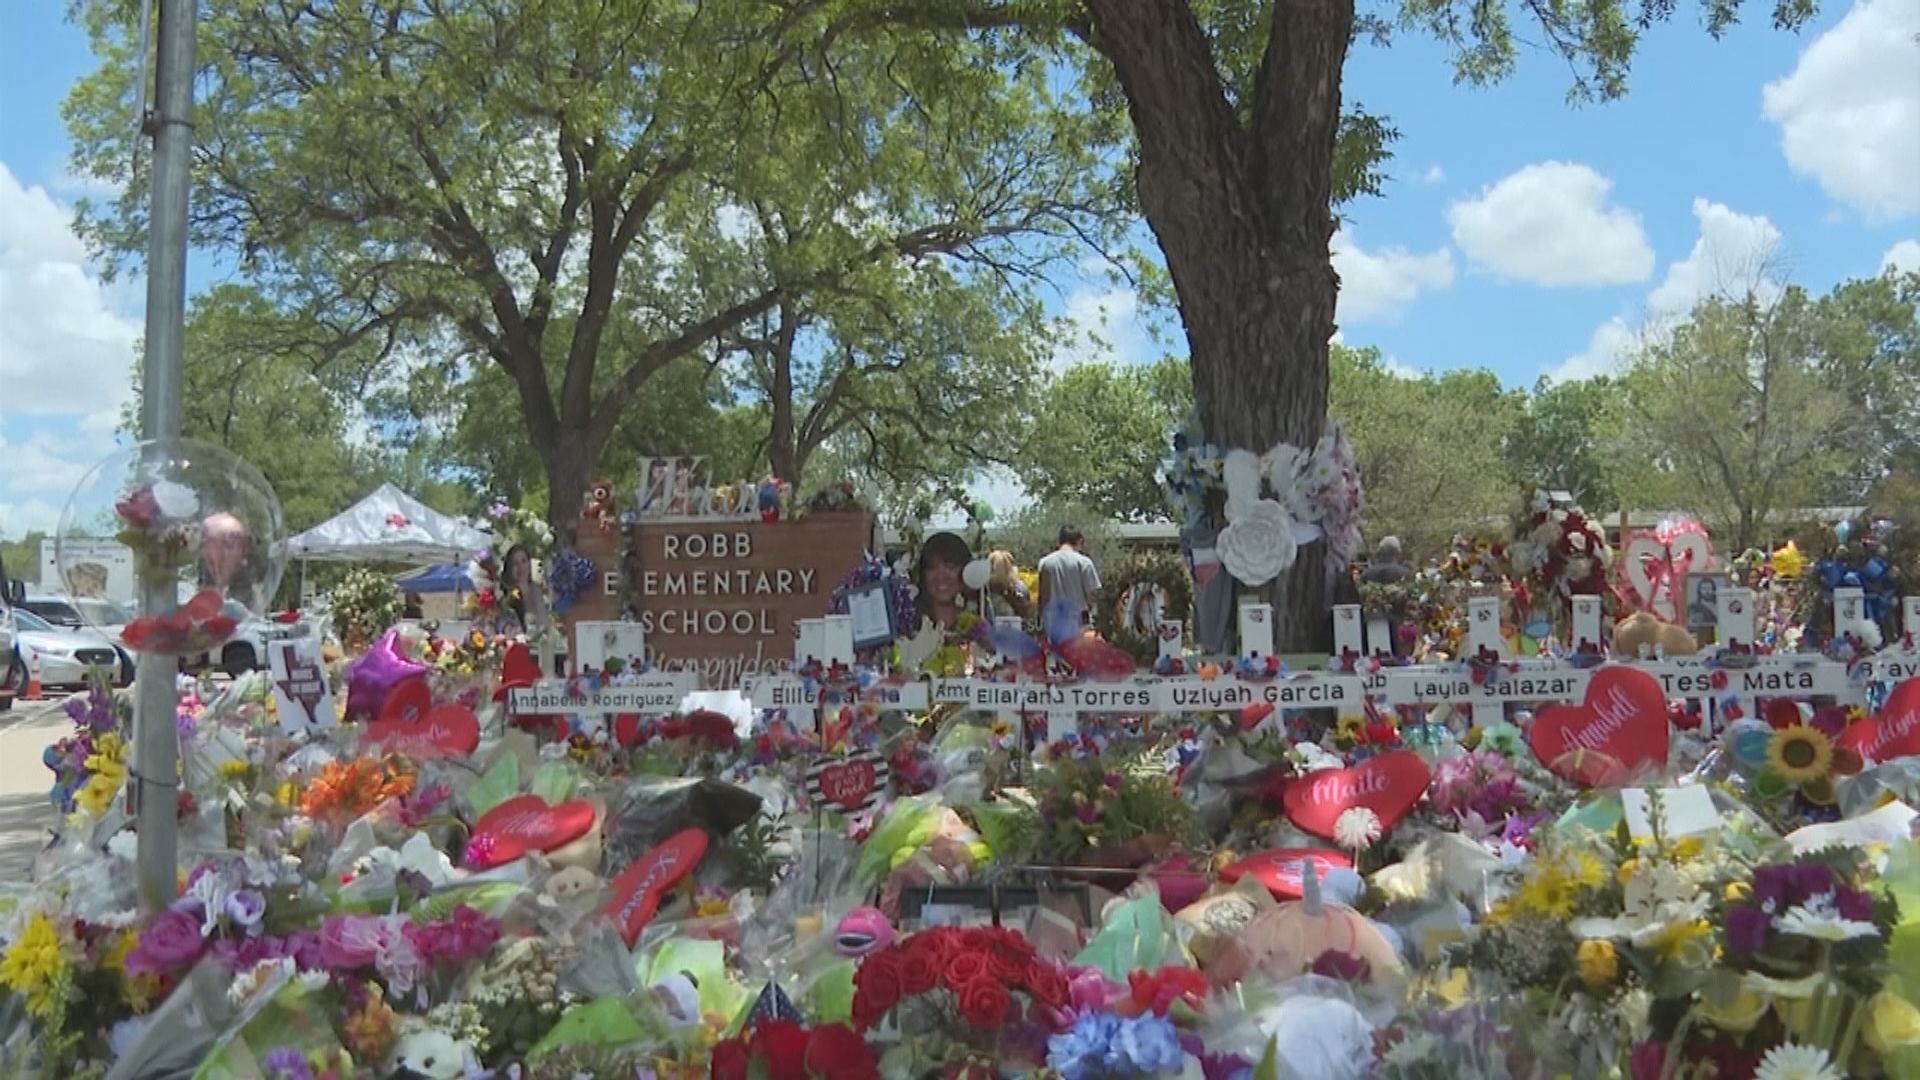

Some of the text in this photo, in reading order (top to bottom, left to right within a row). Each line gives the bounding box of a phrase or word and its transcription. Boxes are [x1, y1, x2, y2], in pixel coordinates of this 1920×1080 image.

[663, 532, 752, 558] ROBB
[604, 567, 816, 595] EEMENTARY
[642, 609, 775, 634] SCHOOL
[1413, 677, 1577, 700] Layla Salazar
[1660, 671, 1814, 693] Tes Mata
[593, 691, 674, 709] Rodriguez
[1071, 688, 1151, 706] Torres
[1172, 683, 1344, 707] Uziyah Garcia
